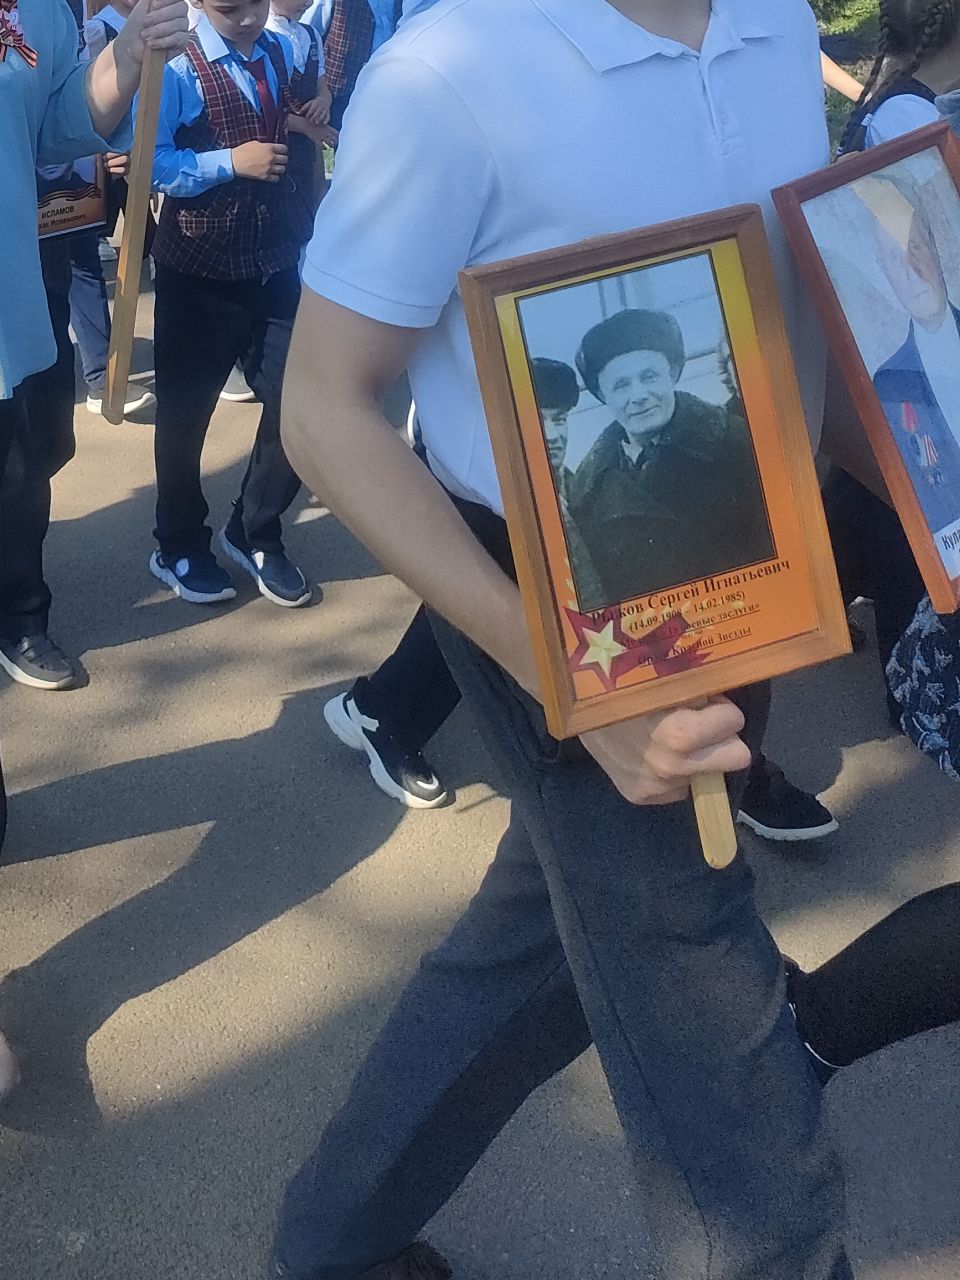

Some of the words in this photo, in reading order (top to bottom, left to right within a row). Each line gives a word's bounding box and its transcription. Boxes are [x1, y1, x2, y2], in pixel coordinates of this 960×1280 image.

[41, 205, 75, 218] ИСЛАМОВ
[647, 582, 700, 609] Сергей
[704, 559, 791, 594] Игнатьевич
[693, 590, 746, 613] 14.02.1985)
